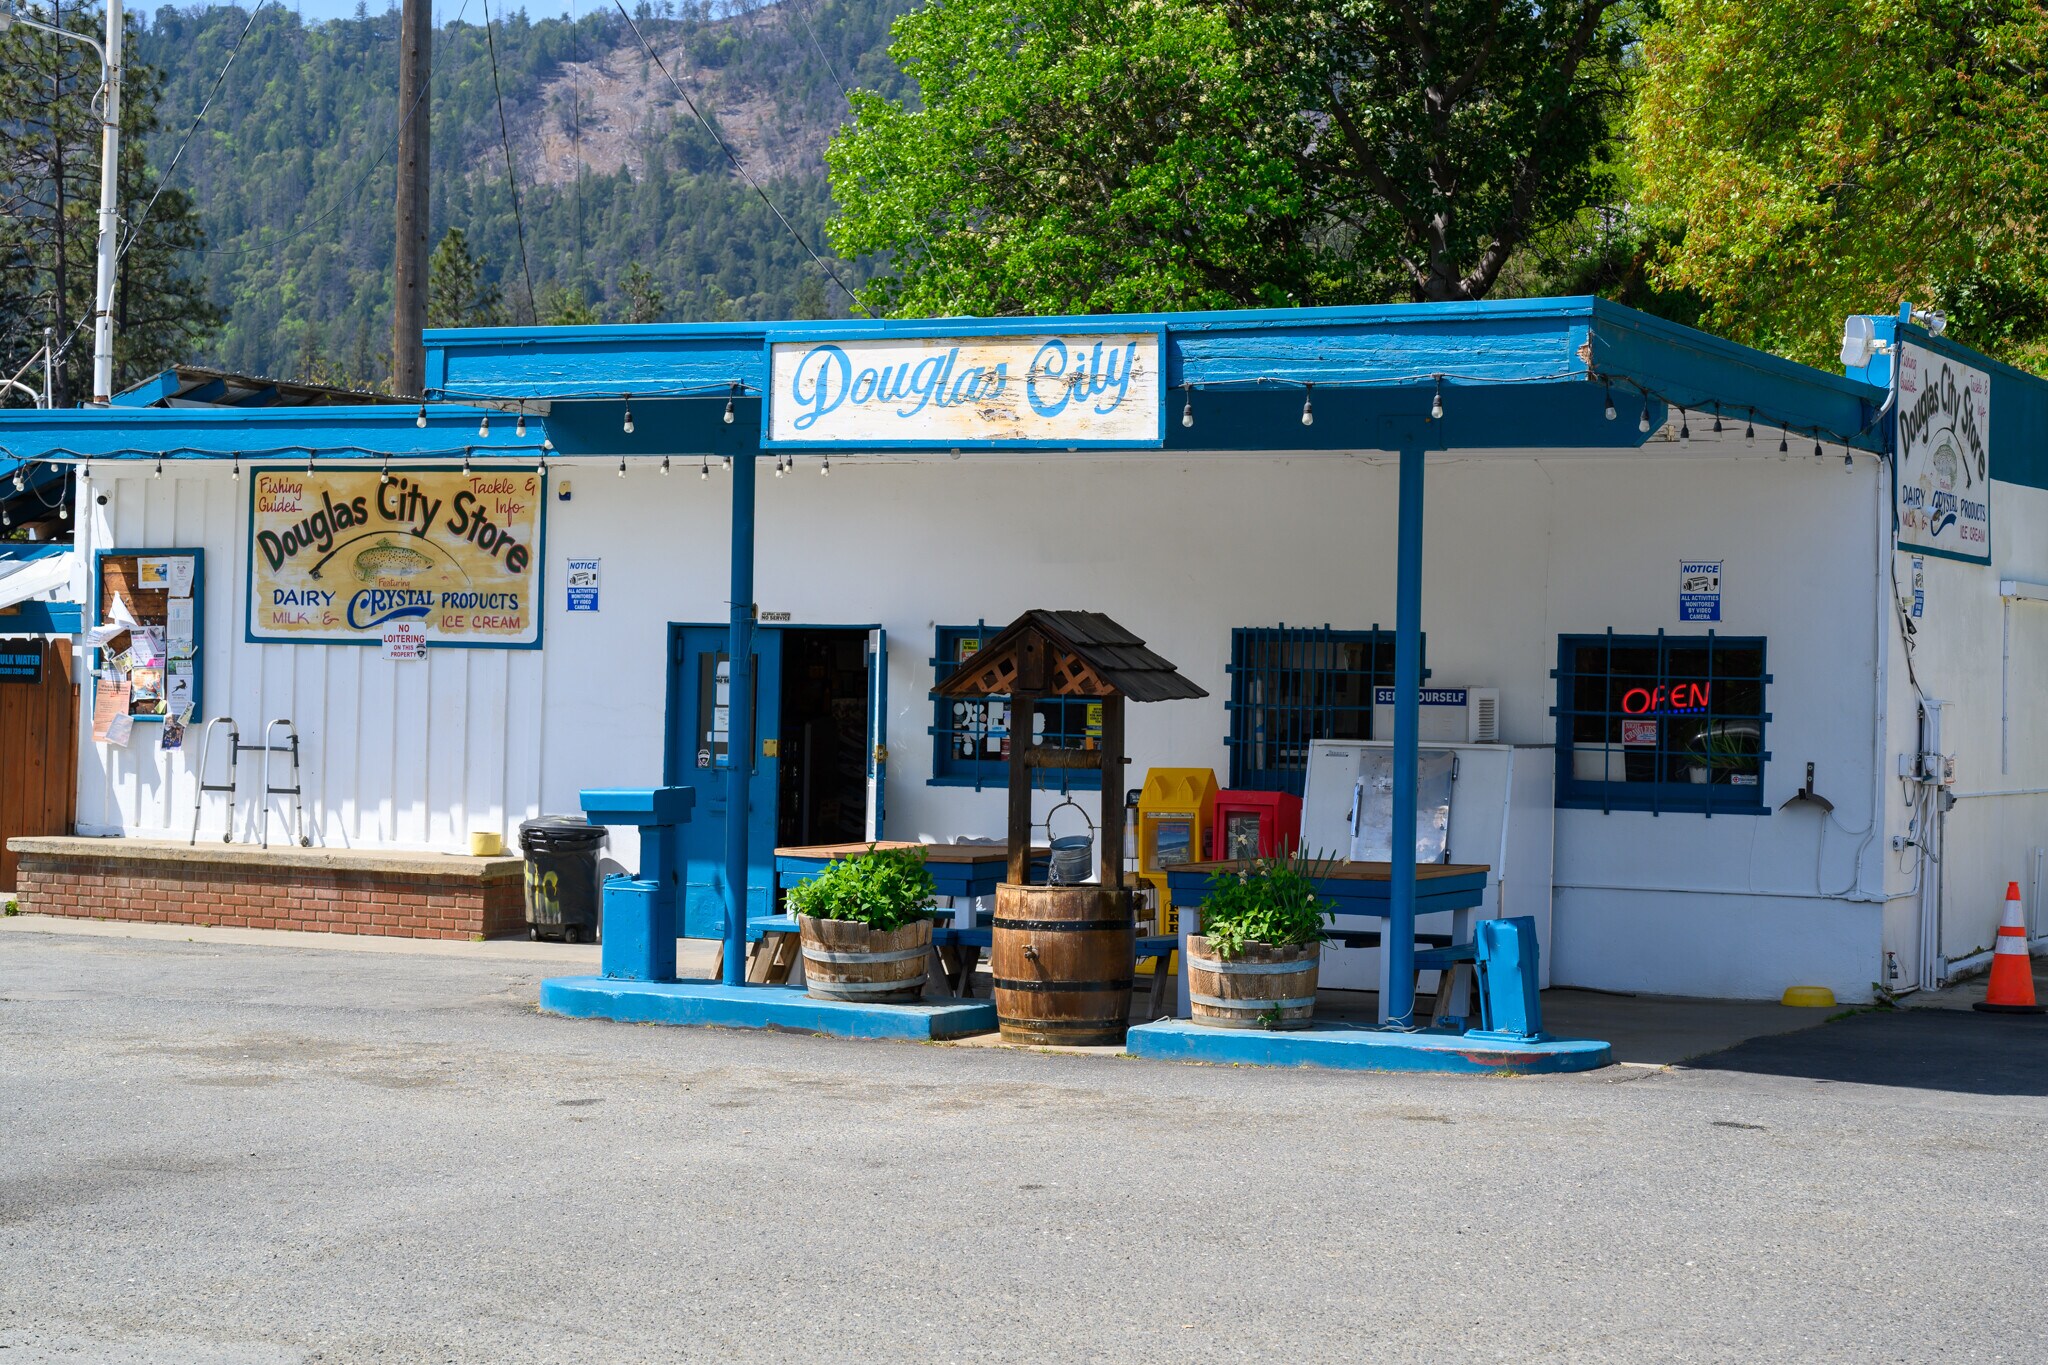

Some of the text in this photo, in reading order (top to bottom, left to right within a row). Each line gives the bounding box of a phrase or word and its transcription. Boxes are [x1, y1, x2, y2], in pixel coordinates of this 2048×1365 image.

[793, 339, 1137, 430] Douglas City
[1899, 363, 1986, 482] Douglas City Store
[260, 477, 536, 500] Fishing Tackle &
[259, 496, 302, 512] Guides
[1902, 484, 1926, 507] DAIRY
[1960, 499, 1986, 522] PRODUCTS
[257, 476, 529, 573] Douglas City Store
[1902, 512, 1917, 528] MILK
[570, 562, 597, 570] NOTICE
[1683, 565, 1719, 573] NOTICE
[378, 577, 410, 590] Featuring
[273, 589, 519, 629] DAIRY CRYSTAL PRODUCTS
[272, 611, 520, 629] MILK & ICE CREAM
[398, 624, 410, 632] NO
[383, 634, 425, 643] LOITERING
[0, 654, 40, 665] ULK WATER
[1418, 692, 1465, 703] OURSELF
[1622, 681, 1710, 714] OPEN
[1624, 725, 1657, 741] CRAWLERS
